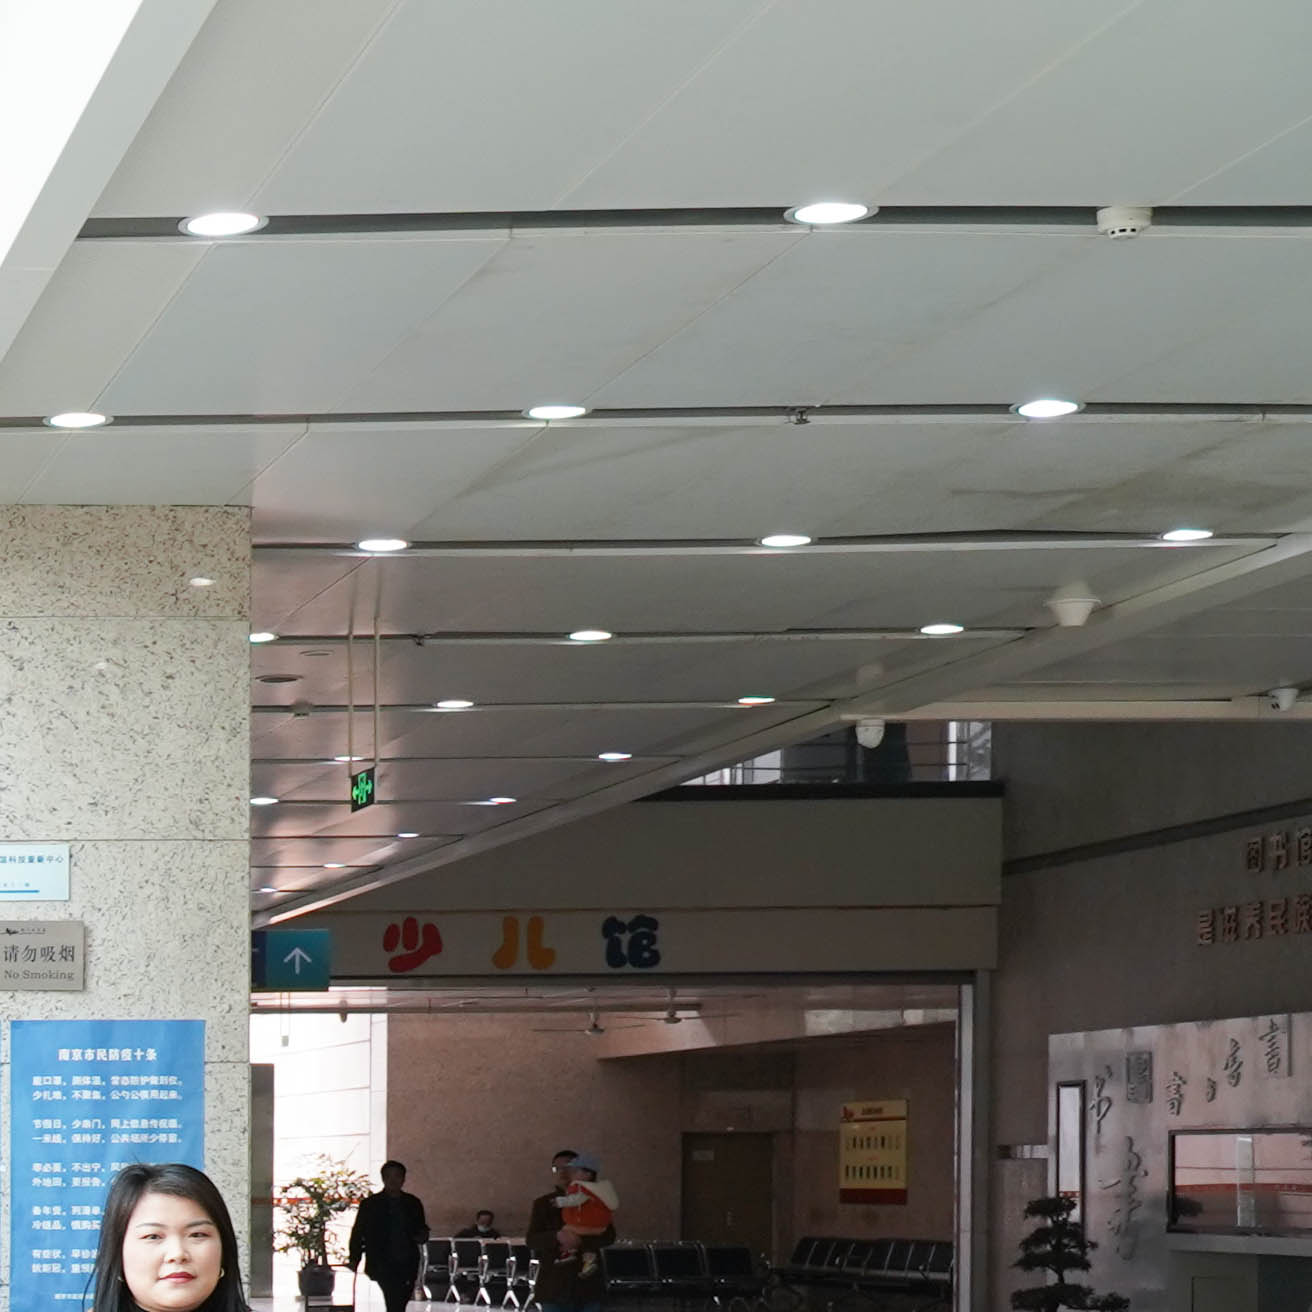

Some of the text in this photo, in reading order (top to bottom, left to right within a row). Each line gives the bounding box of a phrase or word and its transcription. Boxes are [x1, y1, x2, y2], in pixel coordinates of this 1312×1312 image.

[383, 913, 661, 973] 少儿馆
[3, 944, 76, 964] 请勿吸烟
[4, 969, 76, 981] No Smoking
